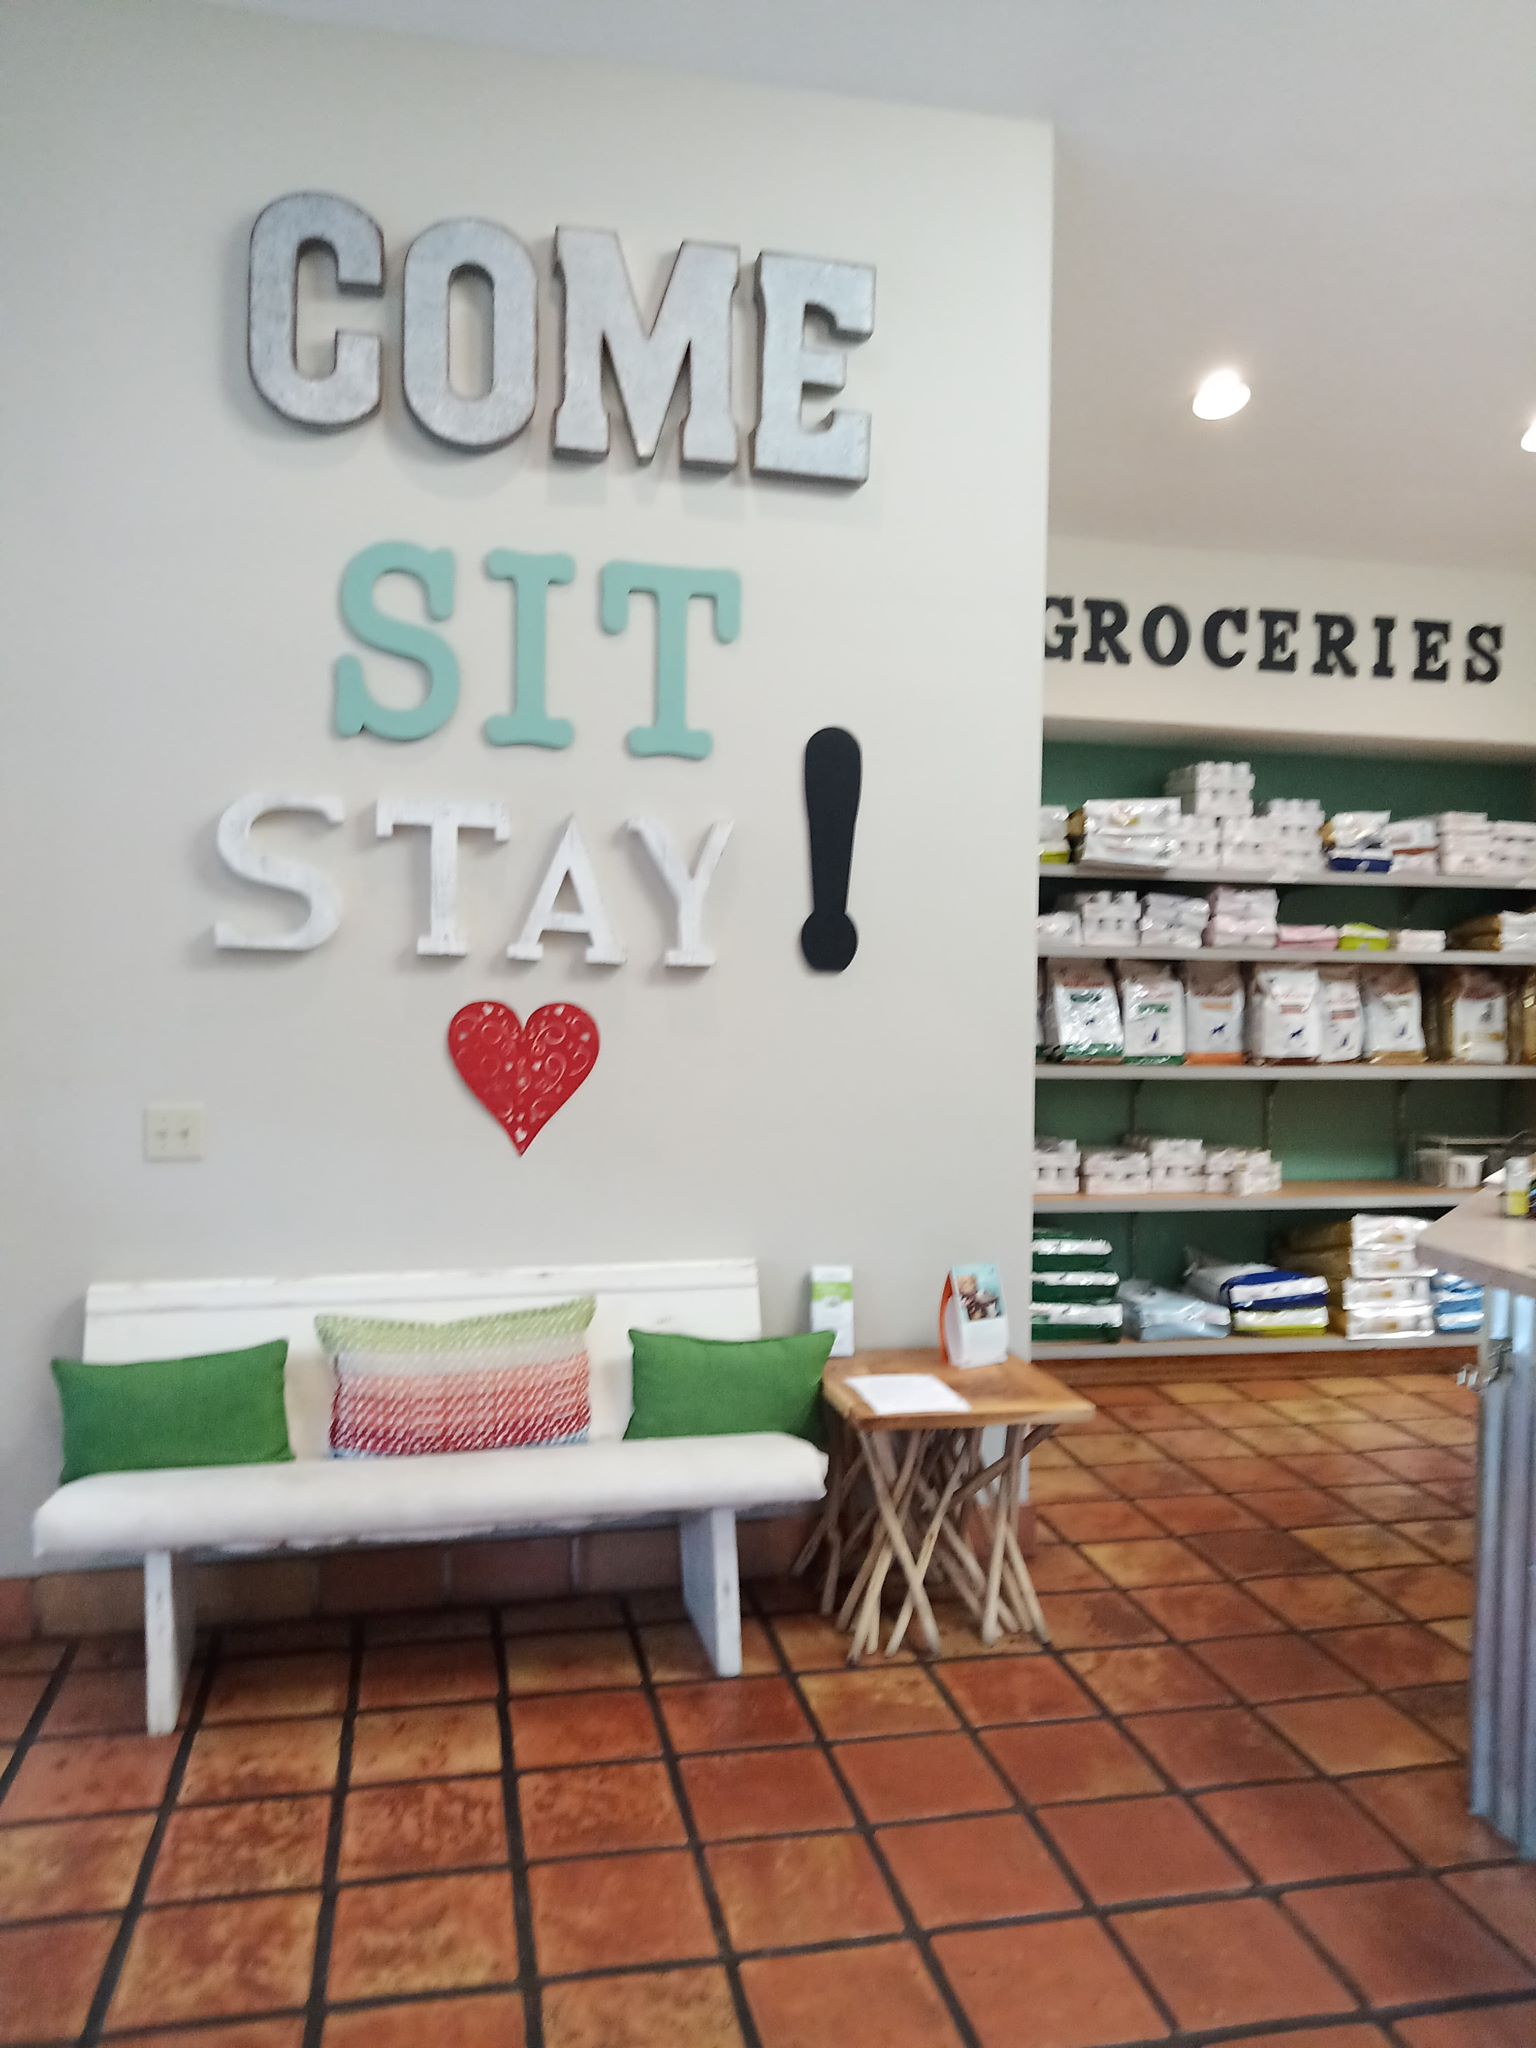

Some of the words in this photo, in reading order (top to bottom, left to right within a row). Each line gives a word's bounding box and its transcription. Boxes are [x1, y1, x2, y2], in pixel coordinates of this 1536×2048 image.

[247, 190, 877, 485] COME
[332, 541, 742, 760] SIT
[1045, 596, 1504, 682] GROCERIES
[213, 791, 735, 967] STAY
